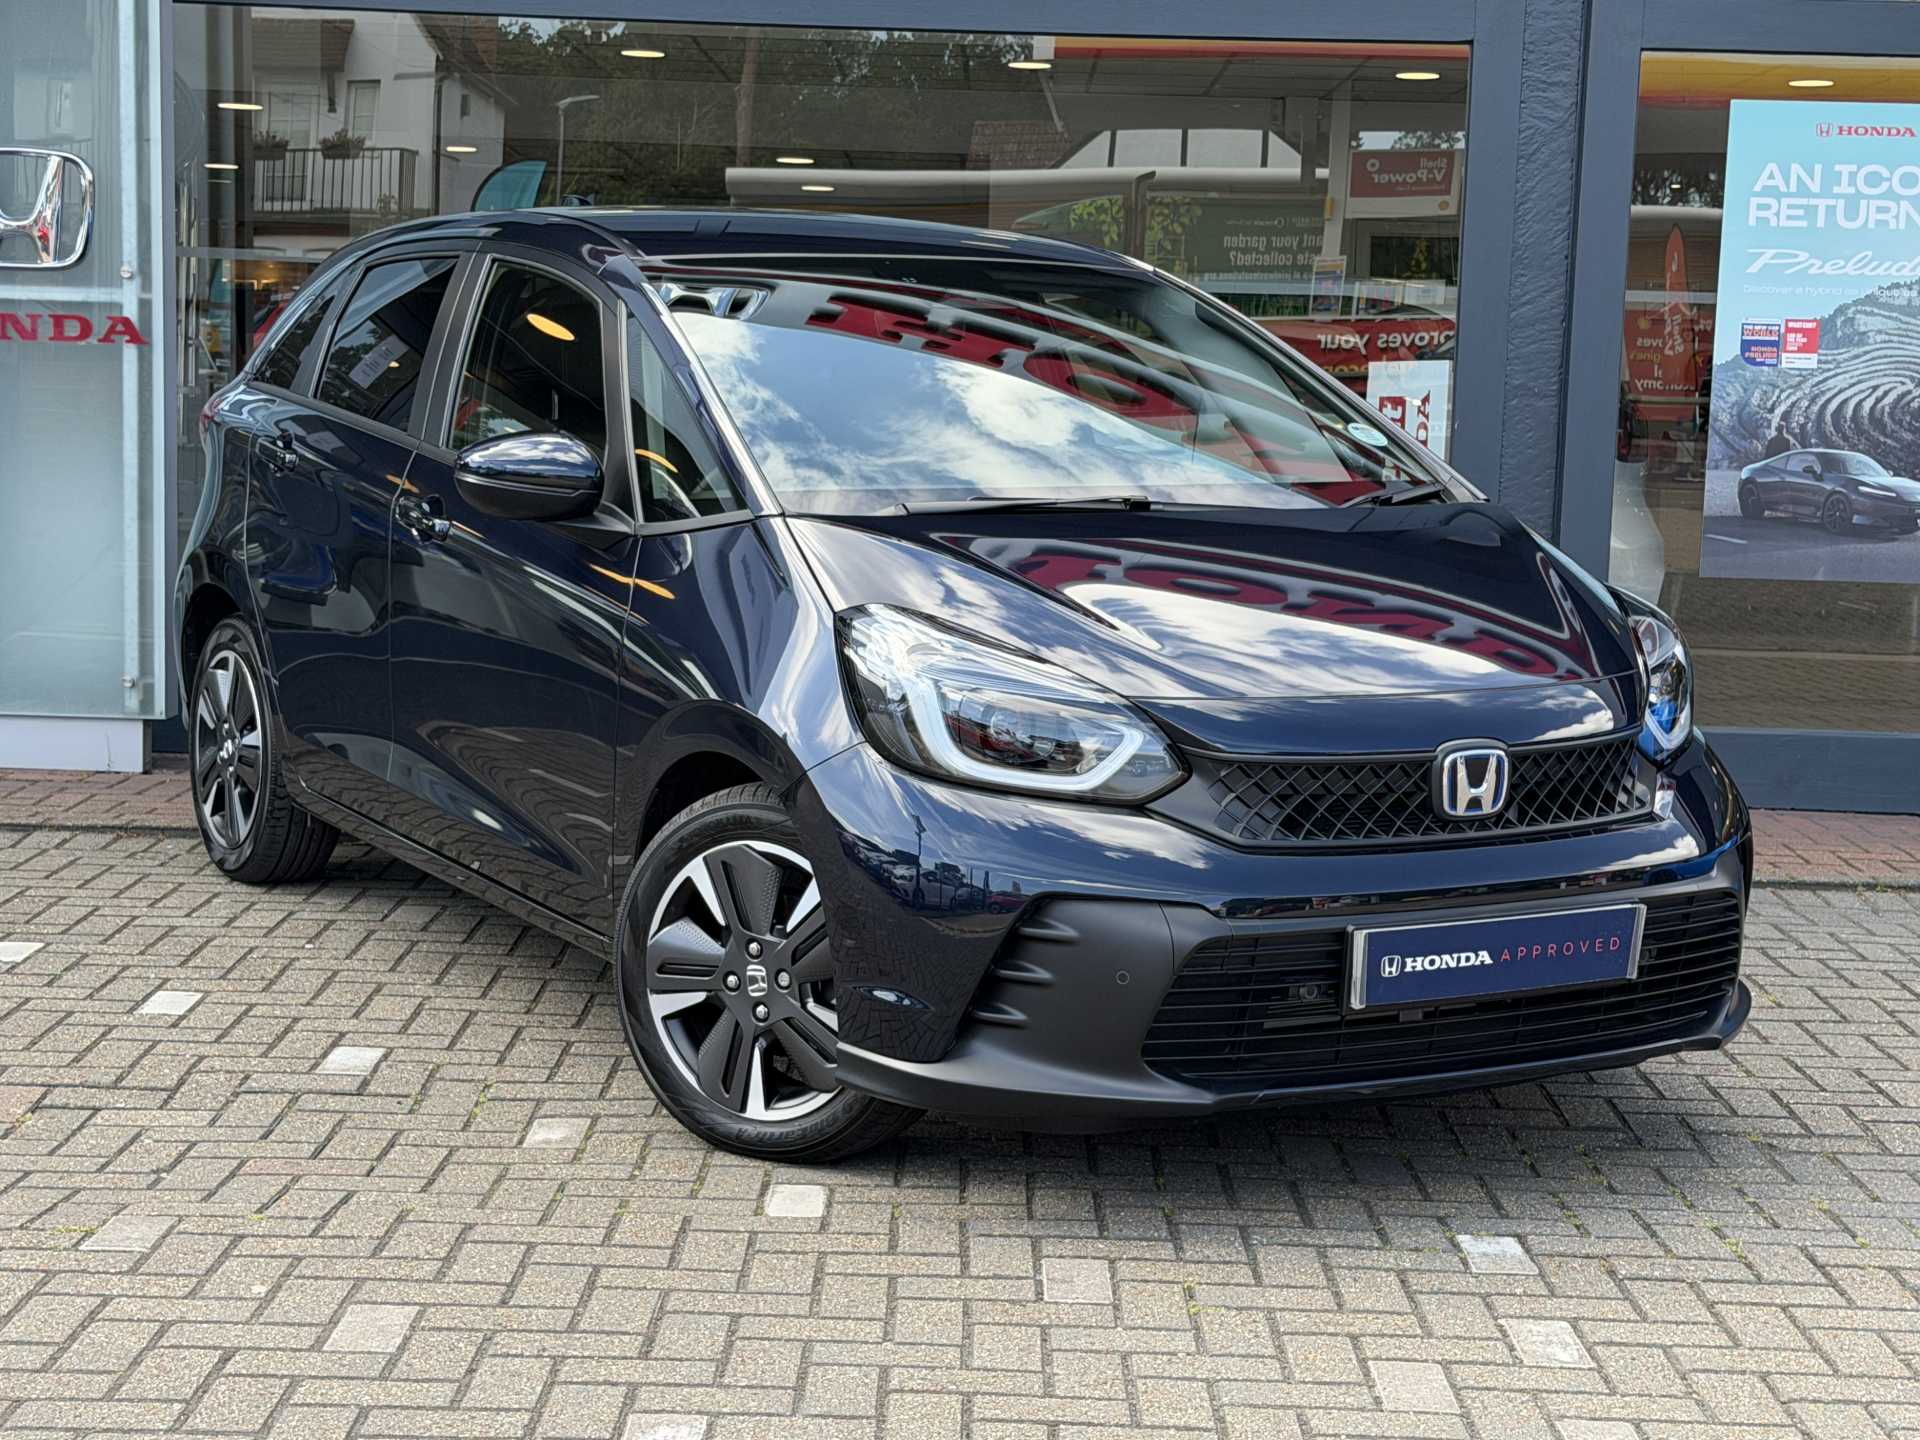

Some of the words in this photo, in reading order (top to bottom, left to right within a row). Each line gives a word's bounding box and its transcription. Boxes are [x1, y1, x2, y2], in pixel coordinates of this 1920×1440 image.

[1837, 125, 1917, 138] HONDA
[1752, 162, 1823, 193] AN
[1832, 164, 1920, 197] ICO
[1747, 197, 1920, 230] RETURN
[1403, 950, 1494, 972] HONDA
[1500, 937, 1621, 963] APPROVED
